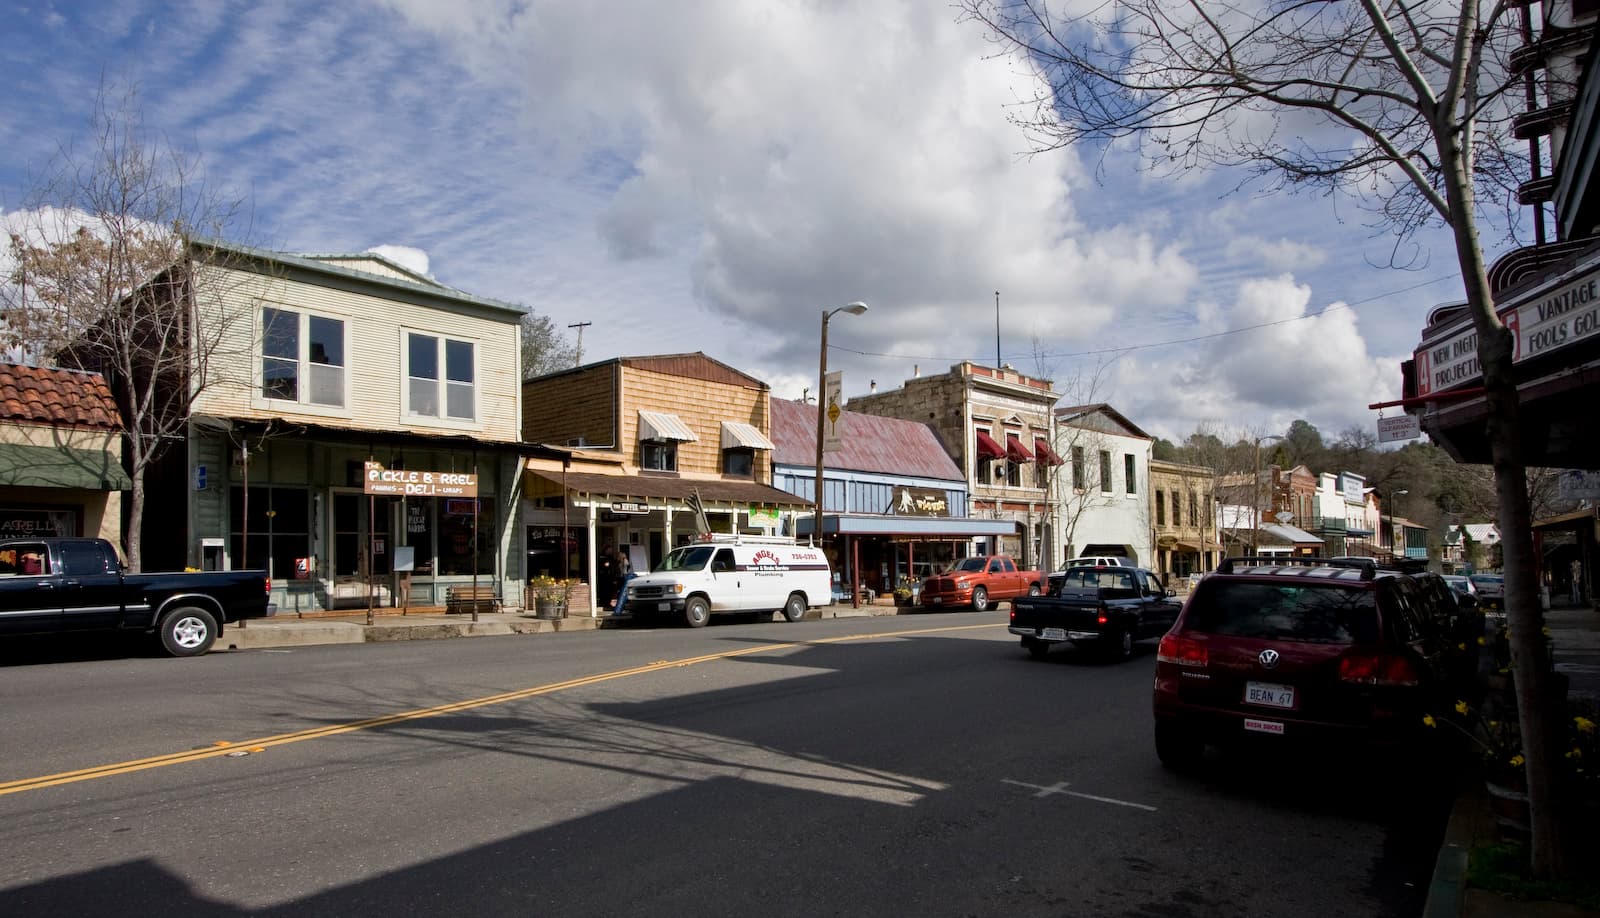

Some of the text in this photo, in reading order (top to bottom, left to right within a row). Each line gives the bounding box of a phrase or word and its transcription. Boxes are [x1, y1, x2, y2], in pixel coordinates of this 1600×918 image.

[1537, 280, 1597, 321] VANTAGE
[1529, 323, 1567, 353] FOOLS
[1433, 334, 1478, 365] NEW DIGIT
[1420, 352, 1429, 393] 4
[1435, 358, 1481, 387] PROJECTIO
[1380, 422, 1417, 432] CLEARANCE
[1384, 417, 1412, 426] VERTICAL
[368, 470, 475, 485] PICKLE BRREL
[405, 483, 436, 495] DELI
[752, 549, 781, 565] ANGELS
[1250, 689, 1292, 704] BEAN 67
